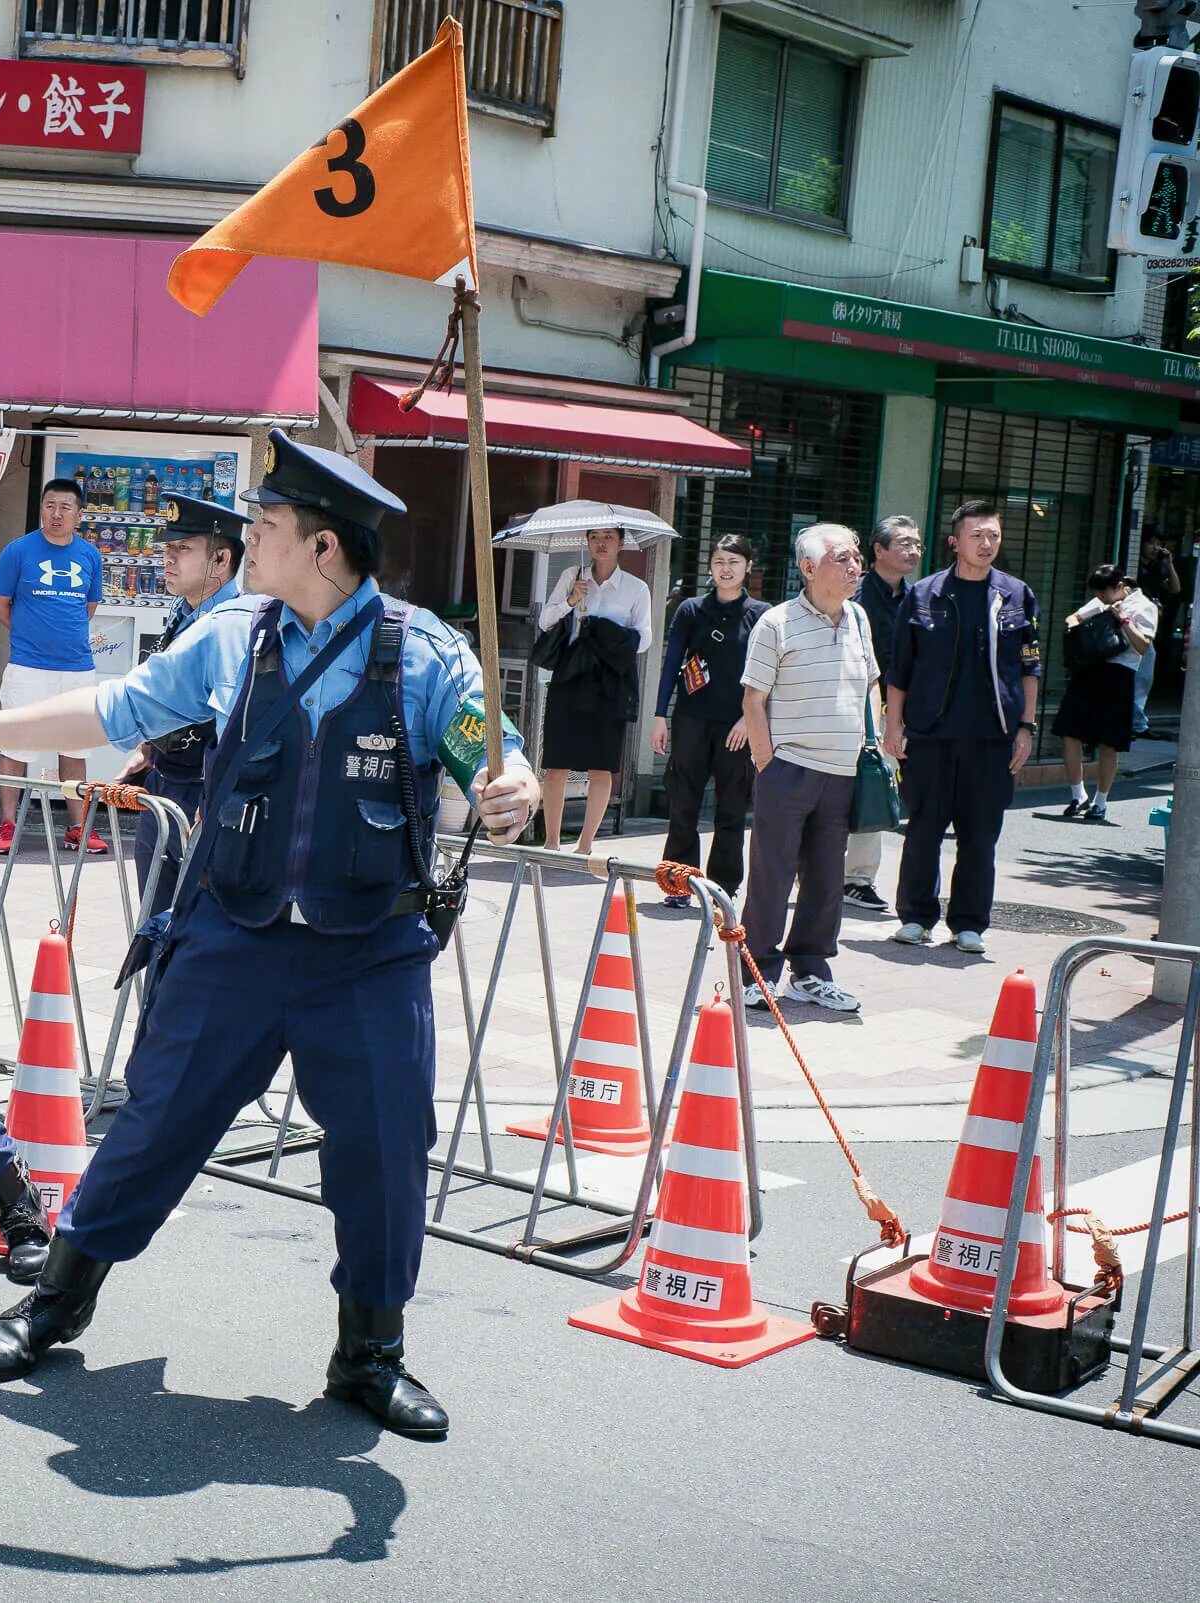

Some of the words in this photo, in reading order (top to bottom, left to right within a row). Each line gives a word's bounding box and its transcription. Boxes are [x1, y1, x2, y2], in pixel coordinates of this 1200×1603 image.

[311, 118, 376, 218] 3
[997, 328, 1038, 354] ITALIA
[1042, 336, 1080, 361] SHOBO
[1163, 358, 1182, 377] TEL
[345, 755, 396, 780] 警視庁
[645, 1267, 718, 1303] 警視庁
